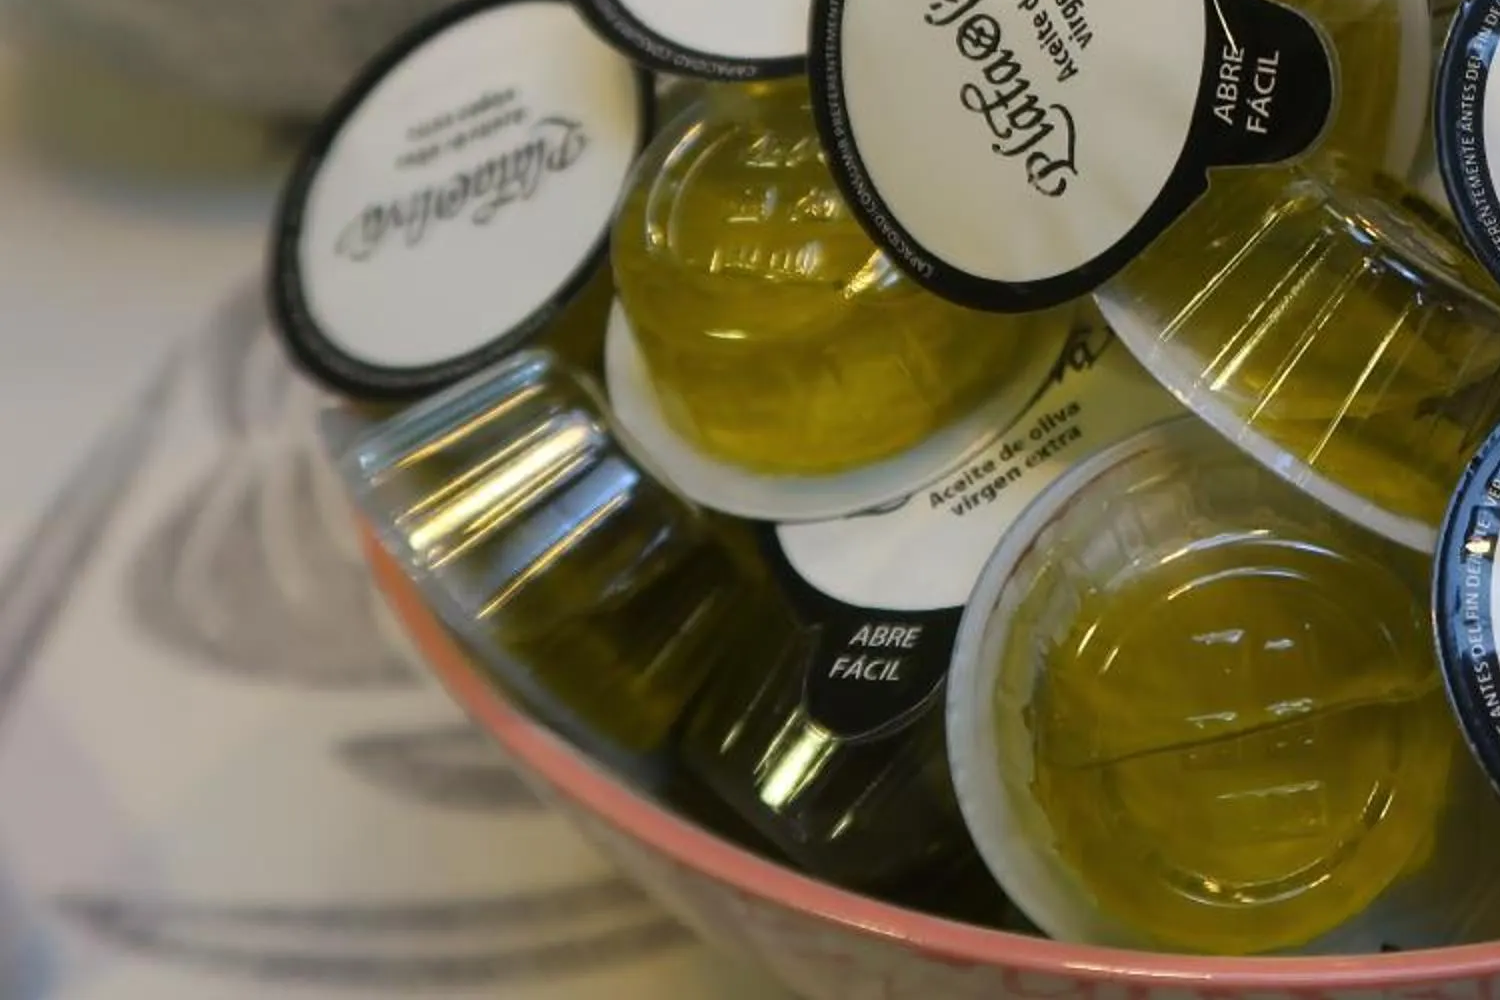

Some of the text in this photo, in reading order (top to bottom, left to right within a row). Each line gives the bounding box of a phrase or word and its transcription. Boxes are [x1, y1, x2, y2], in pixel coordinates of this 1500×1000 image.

[1033, 10, 1079, 83] Aceite
[1213, 45, 1245, 126] ABRE
[1245, 49, 1281, 134] FÁCIL
[1460, 83, 1477, 133] ANTES
[928, 399, 1083, 510] Aceite de oliva
[950, 423, 1084, 518] virgen extra
[848, 624, 923, 650] ABRE
[1465, 594, 1480, 620] FIN
[828, 653, 902, 682] FÁCIL
